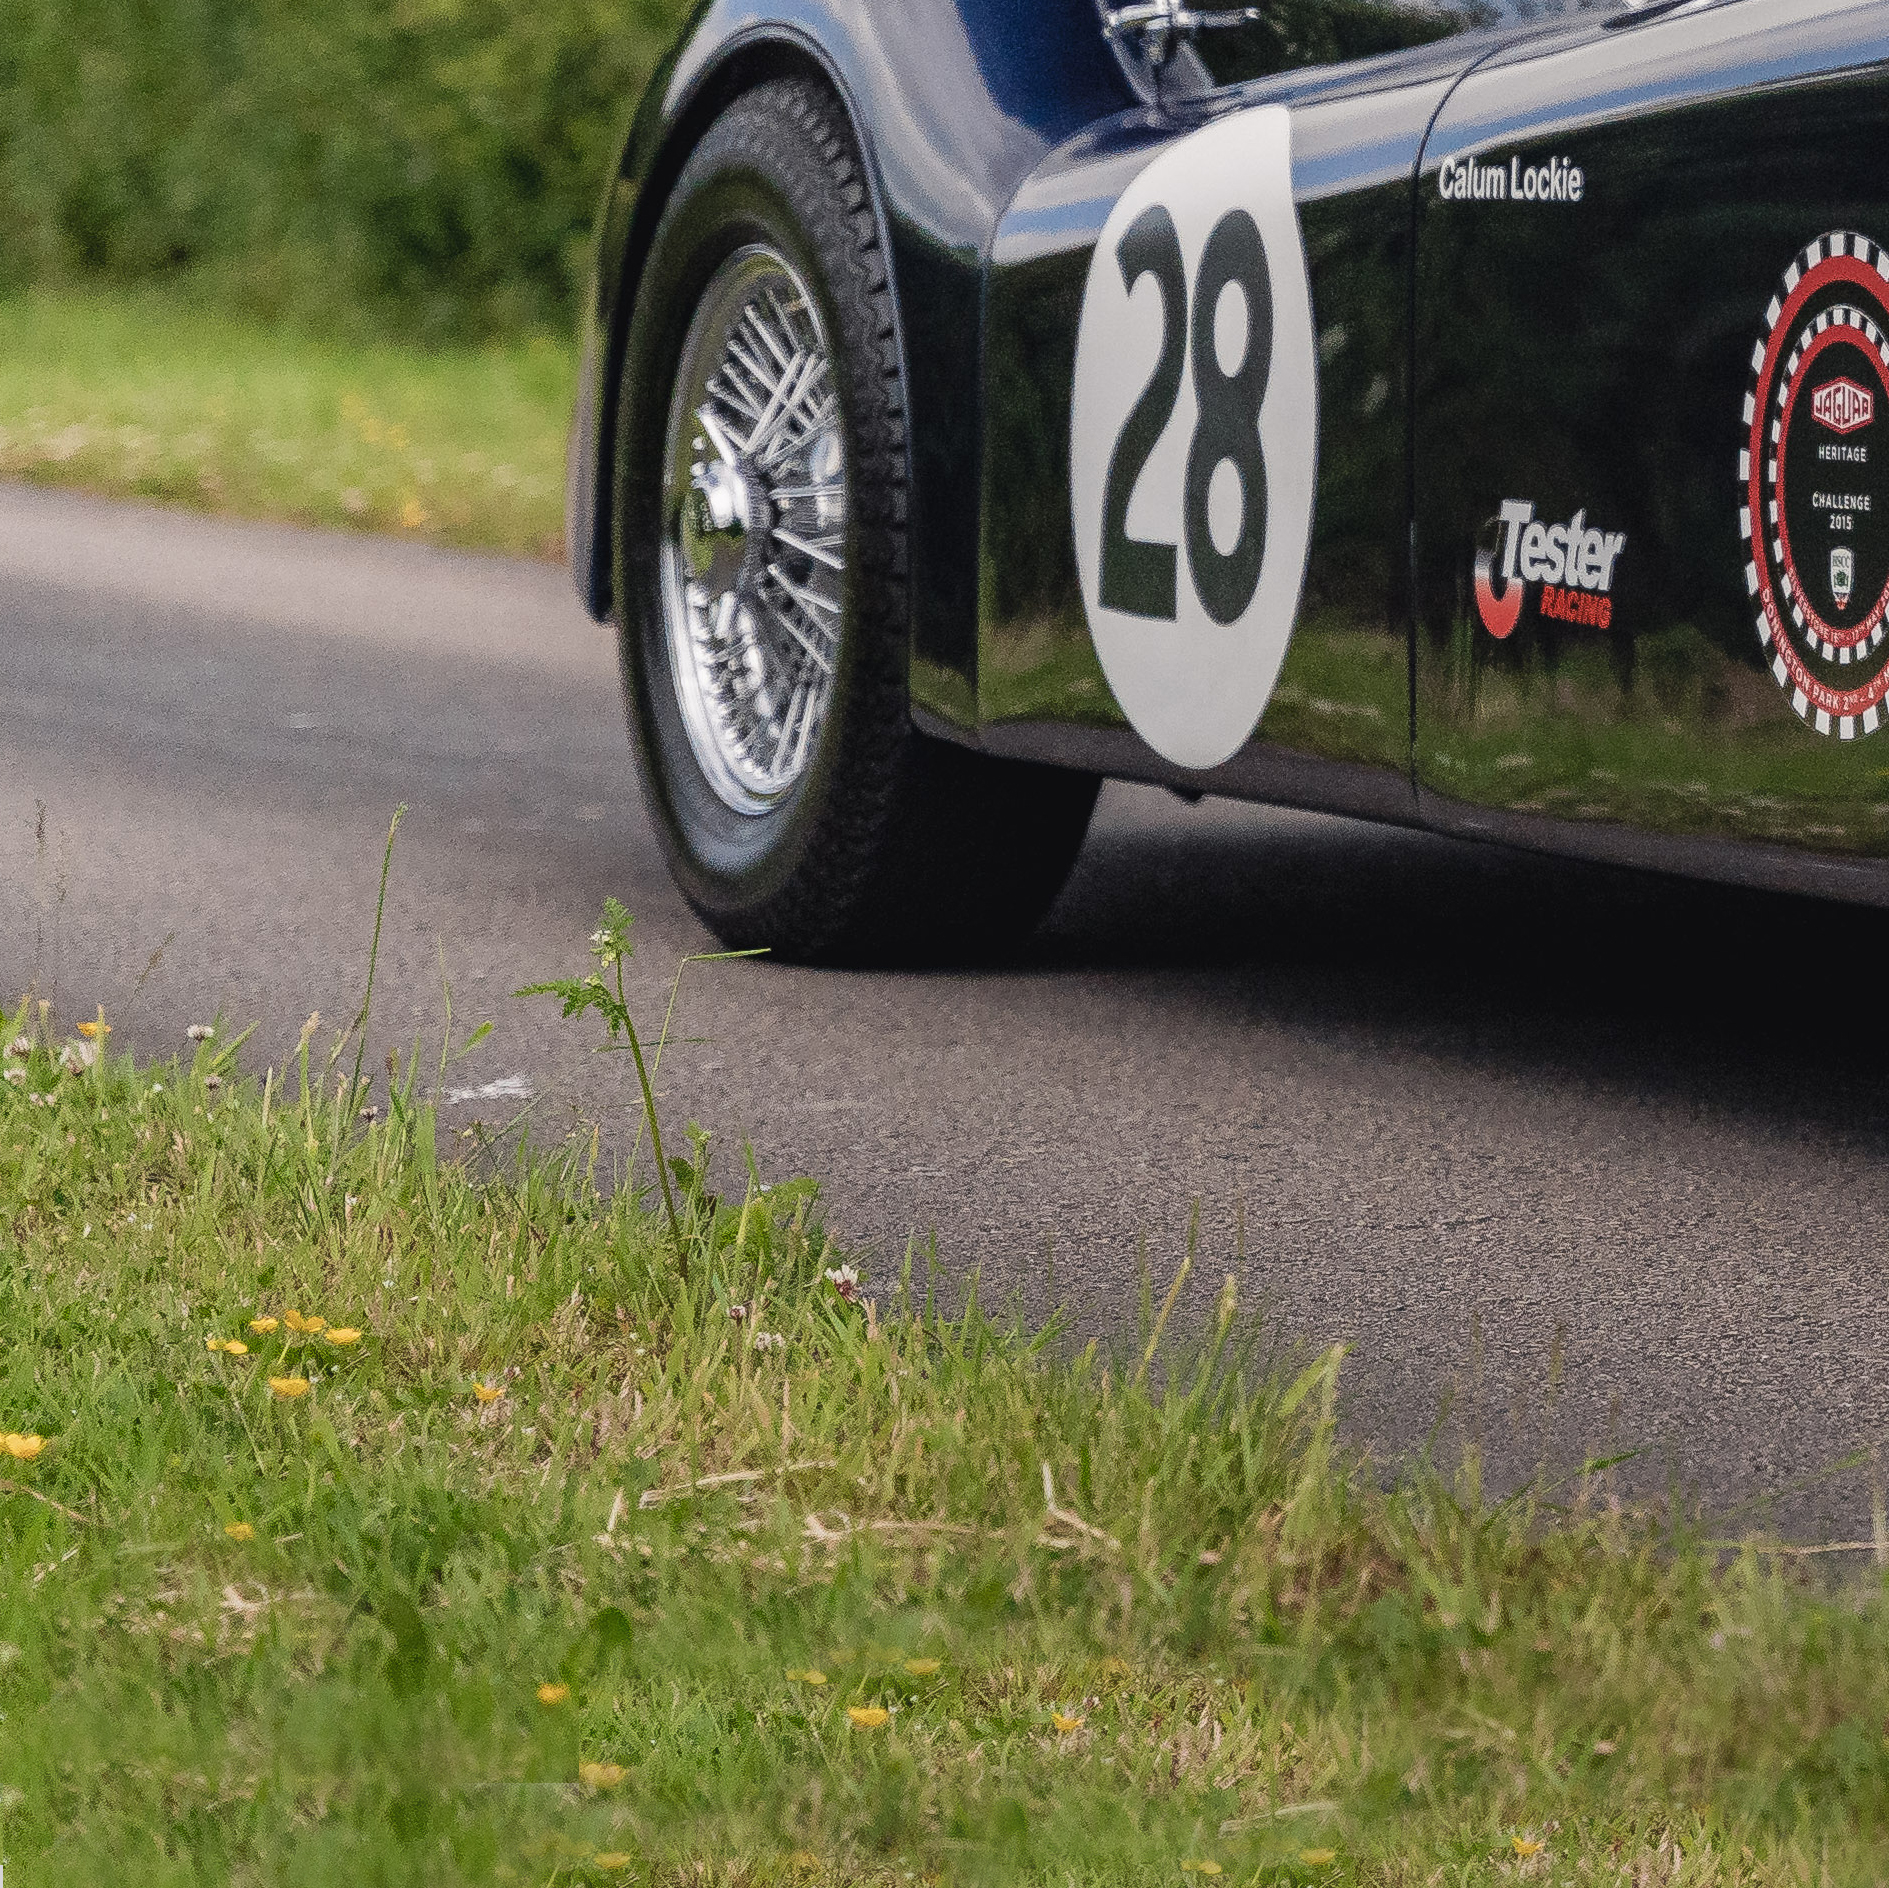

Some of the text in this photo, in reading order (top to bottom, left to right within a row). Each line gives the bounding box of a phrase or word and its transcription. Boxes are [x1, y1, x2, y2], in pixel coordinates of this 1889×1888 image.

[1439, 155, 1584, 201] Calum Lockie
[1099, 204, 1273, 627] 28
[1815, 385, 1869, 425] JAGUAR
[1818, 445, 1867, 463] HERITAGE
[1812, 492, 1871, 511] CHALLENGE
[1829, 514, 1852, 530] 2015
[1500, 499, 1627, 591] Tester
[1763, 588, 1810, 693] DONINGTON
[1812, 685, 1839, 711] PARK
